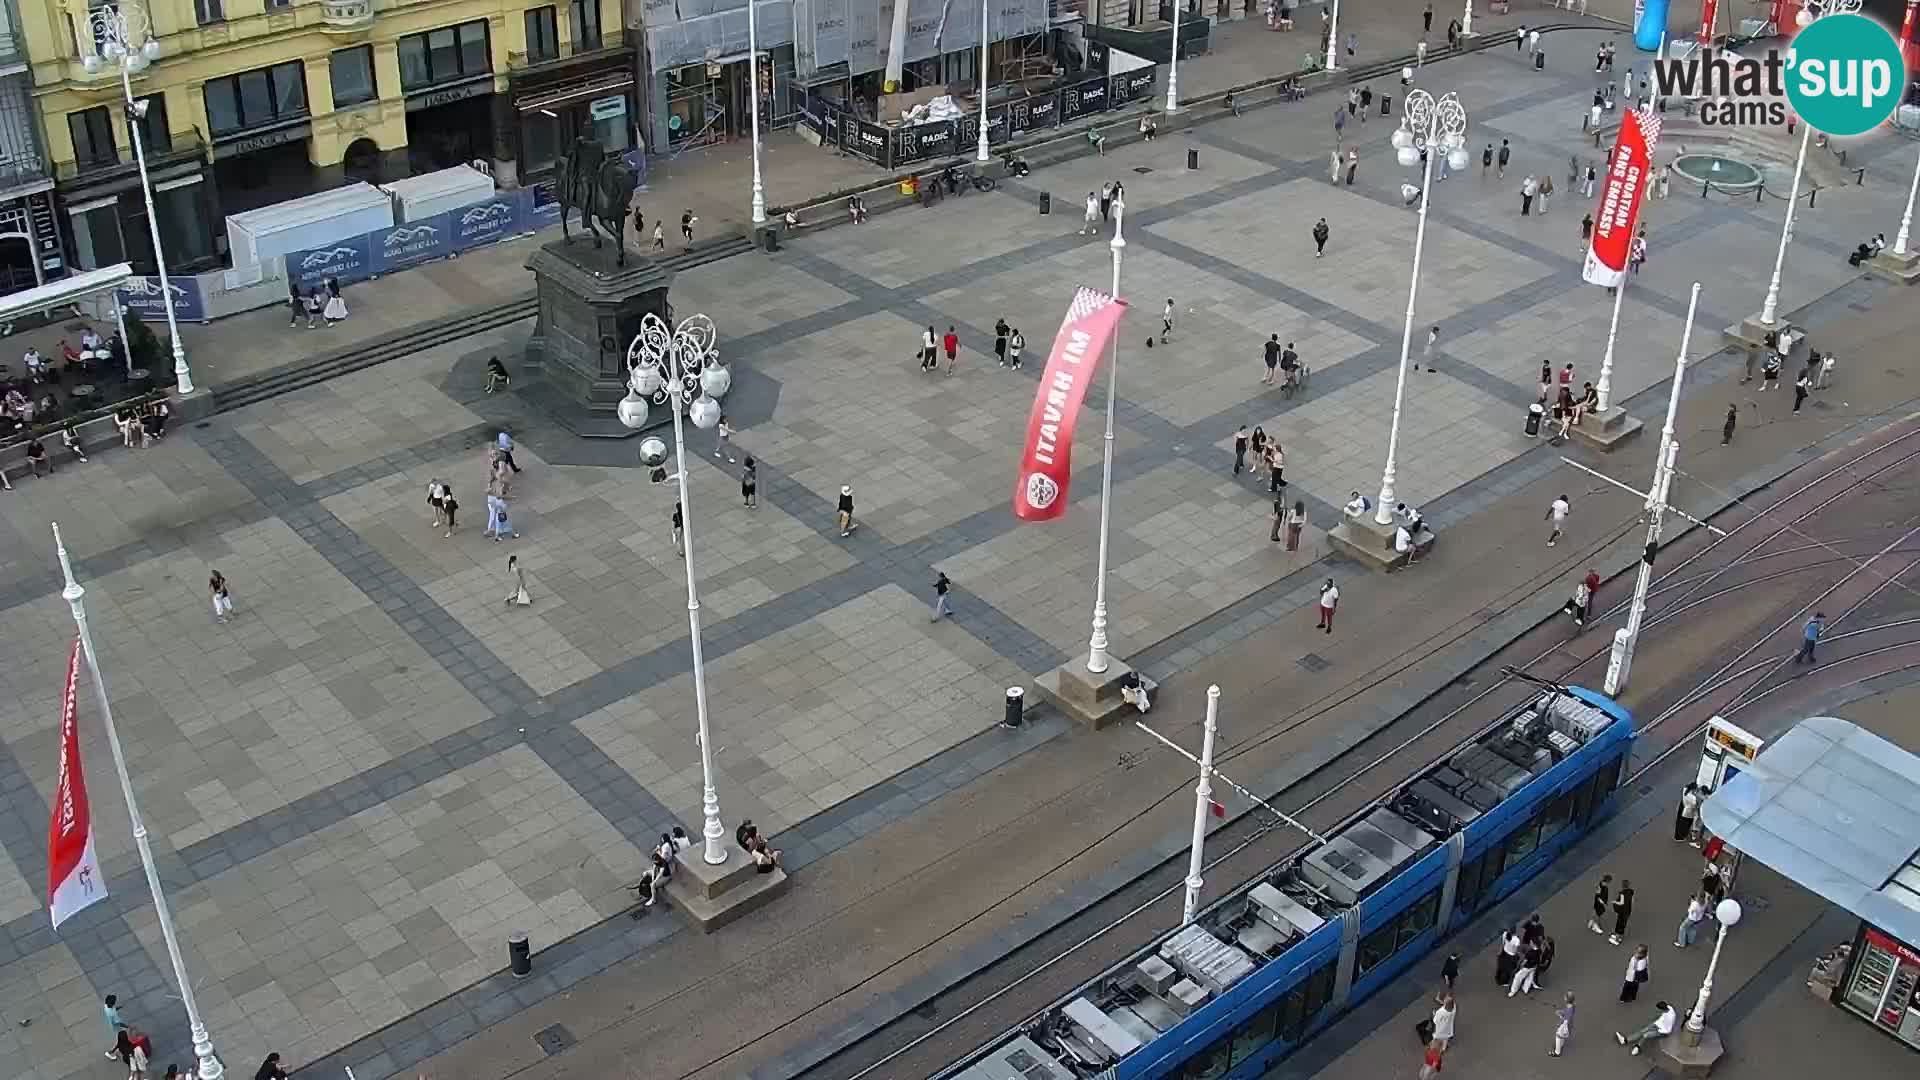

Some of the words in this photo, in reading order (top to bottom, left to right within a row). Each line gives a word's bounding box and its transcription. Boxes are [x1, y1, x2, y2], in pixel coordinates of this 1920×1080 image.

[1613, 144, 1633, 179] FANS
[1598, 180, 1623, 239] EMBASSY
[1615, 166, 1641, 228] CROATIAN
